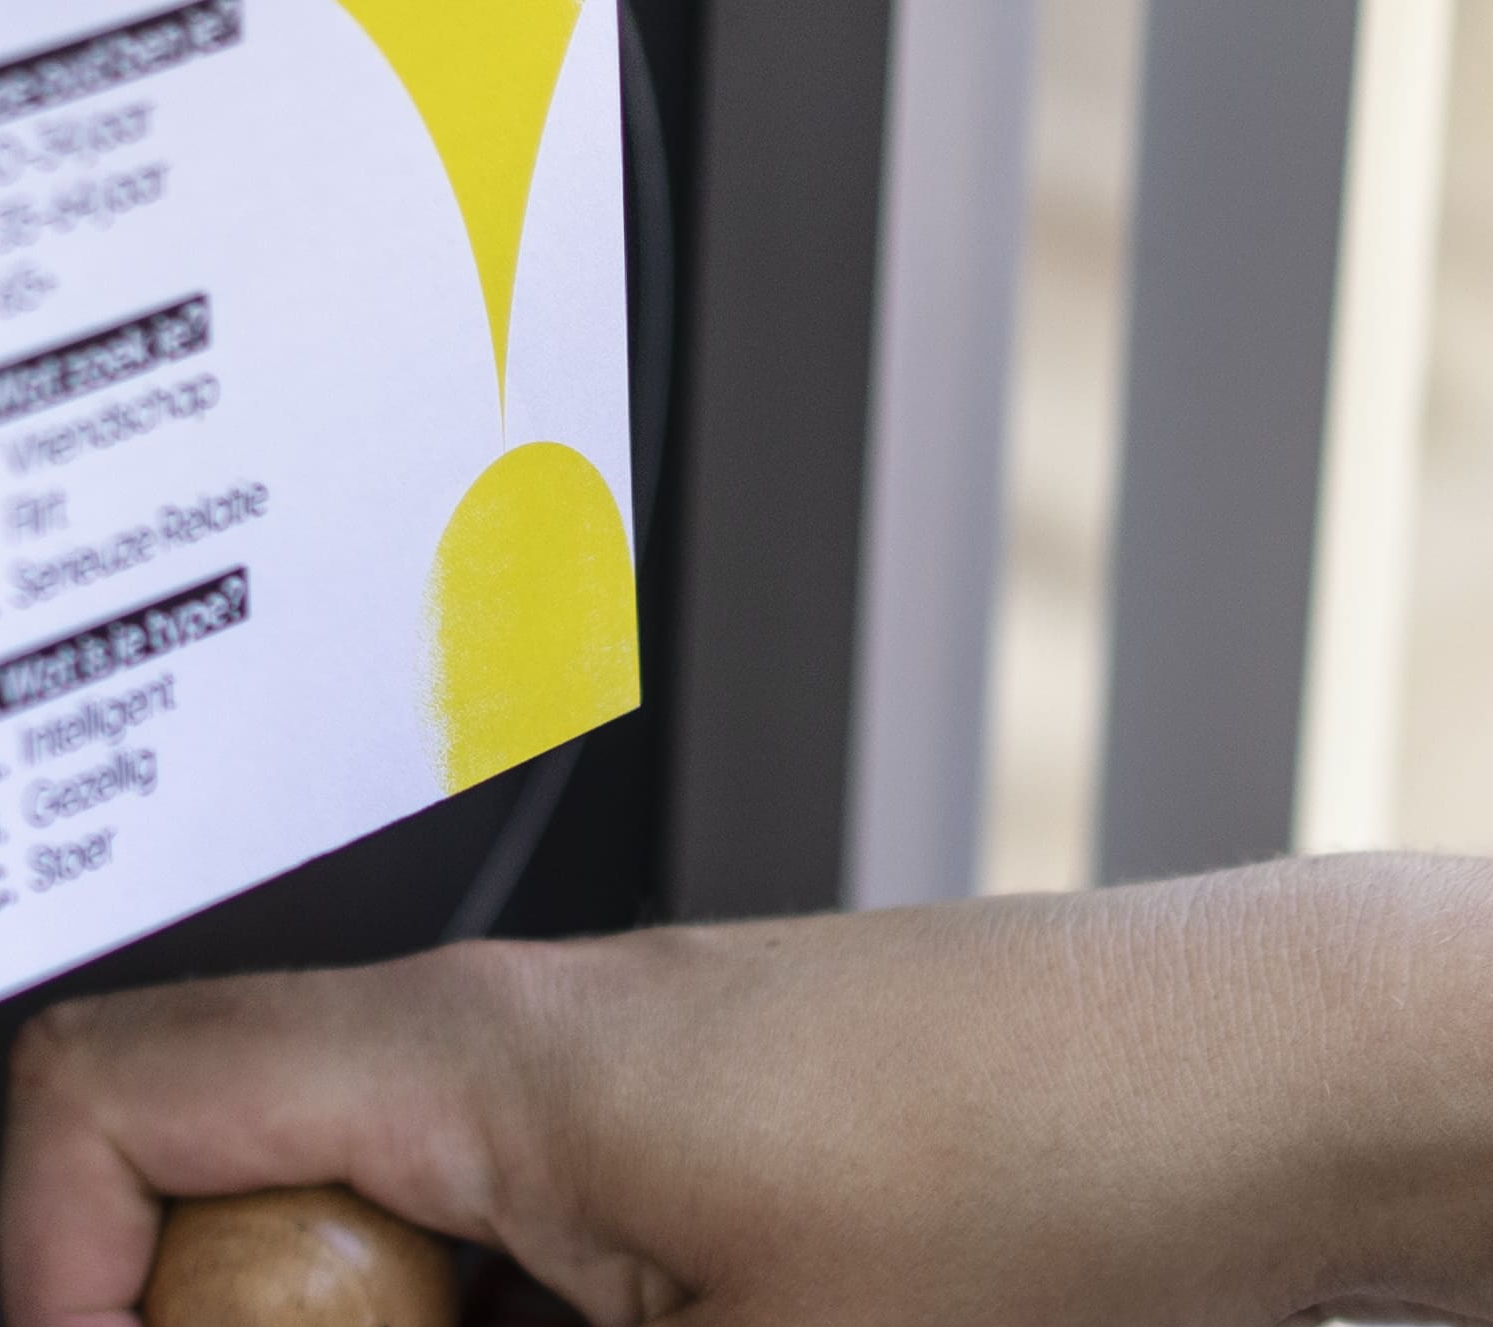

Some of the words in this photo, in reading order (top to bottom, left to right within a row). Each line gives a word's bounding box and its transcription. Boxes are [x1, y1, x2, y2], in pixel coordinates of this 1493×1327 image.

[22, 675, 177, 766] Intelligent
[21, 749, 158, 828] Gezellig
[27, 829, 117, 892] Stoer
